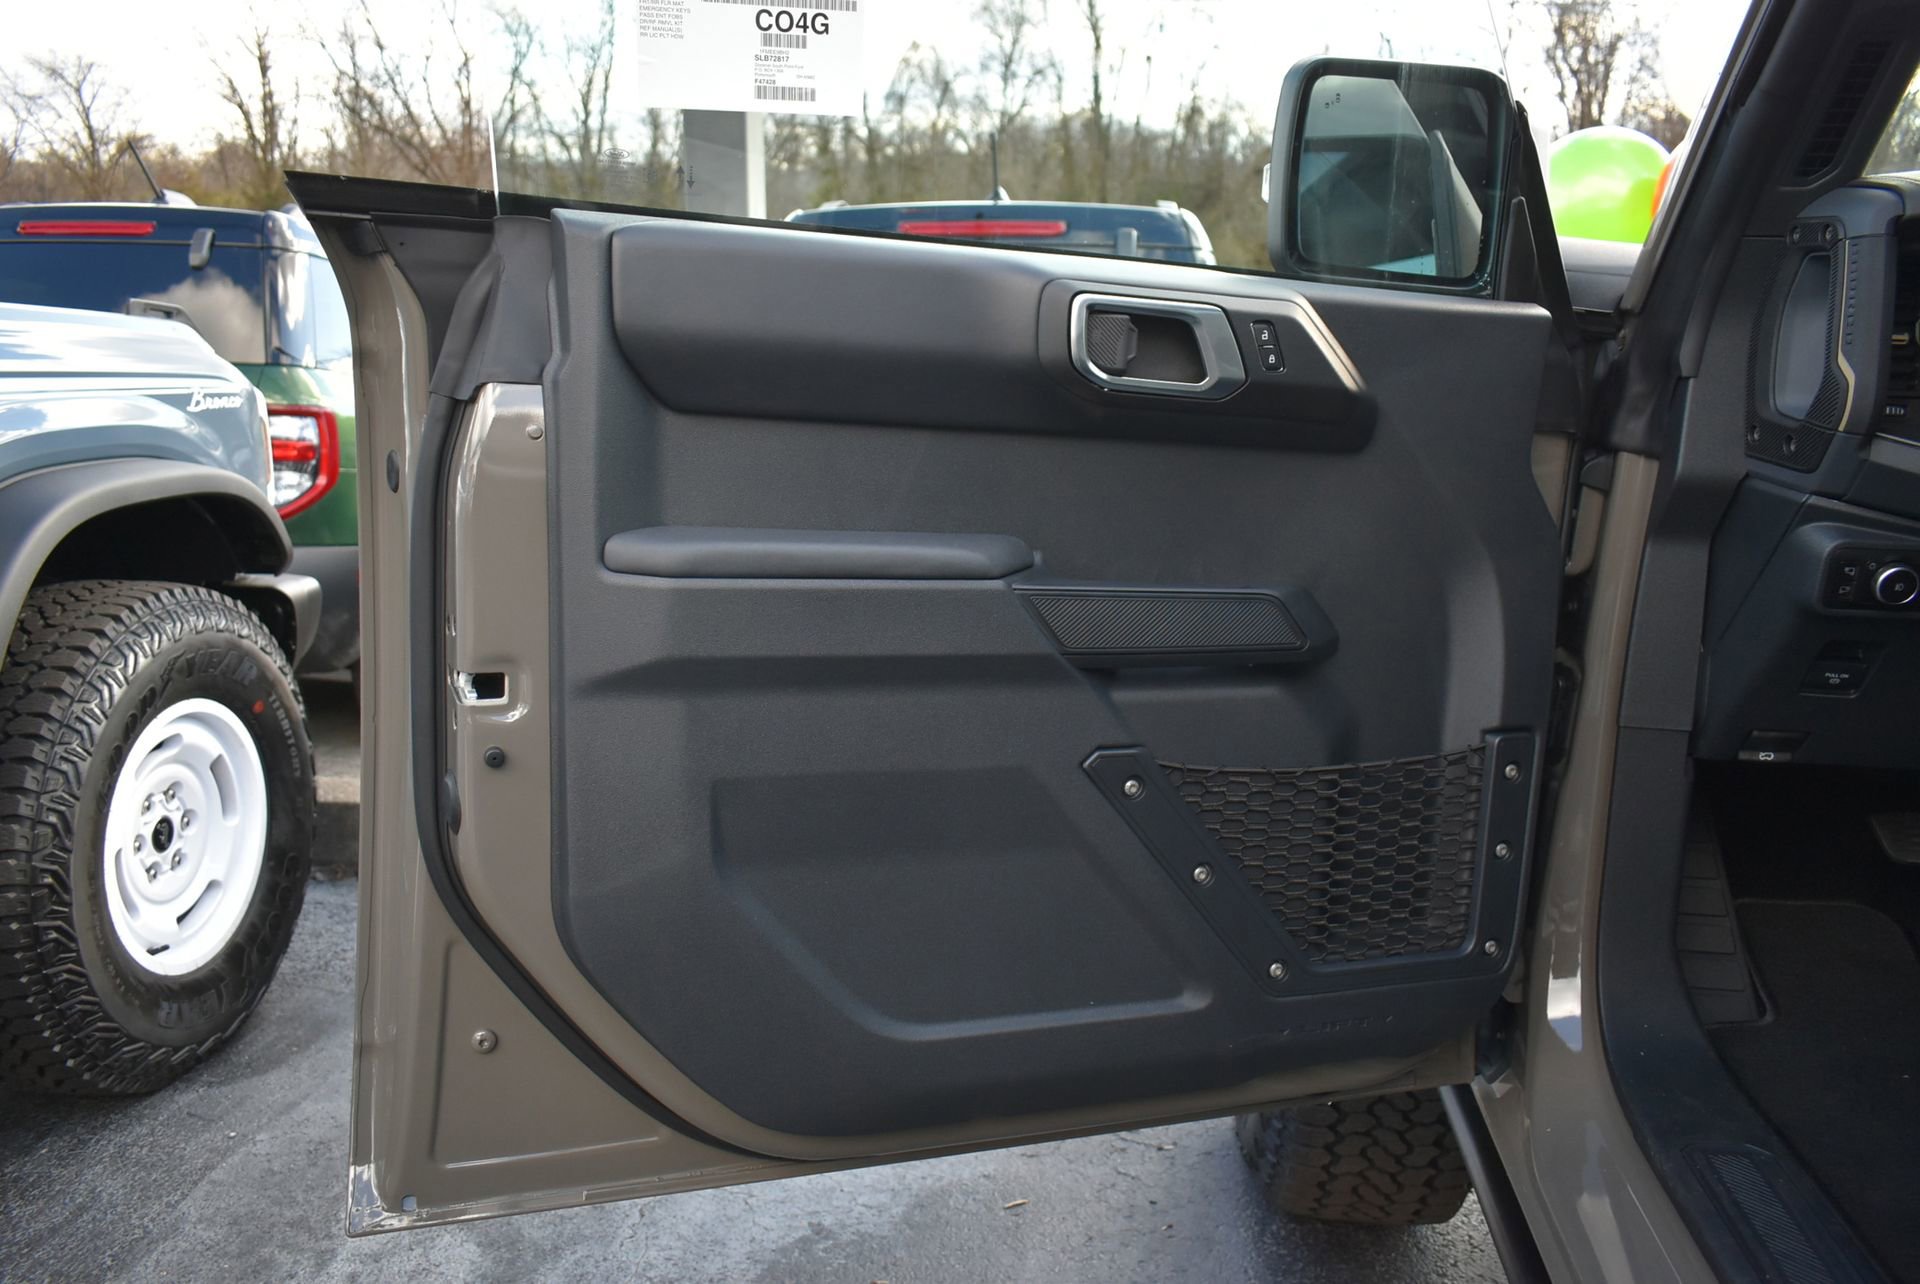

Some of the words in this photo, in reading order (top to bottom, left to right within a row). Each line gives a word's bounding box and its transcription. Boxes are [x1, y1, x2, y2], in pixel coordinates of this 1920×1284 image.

[755, 8, 829, 35] CO4G
[754, 54, 790, 62] SLB72817
[186, 388, 243, 412] Bronco
